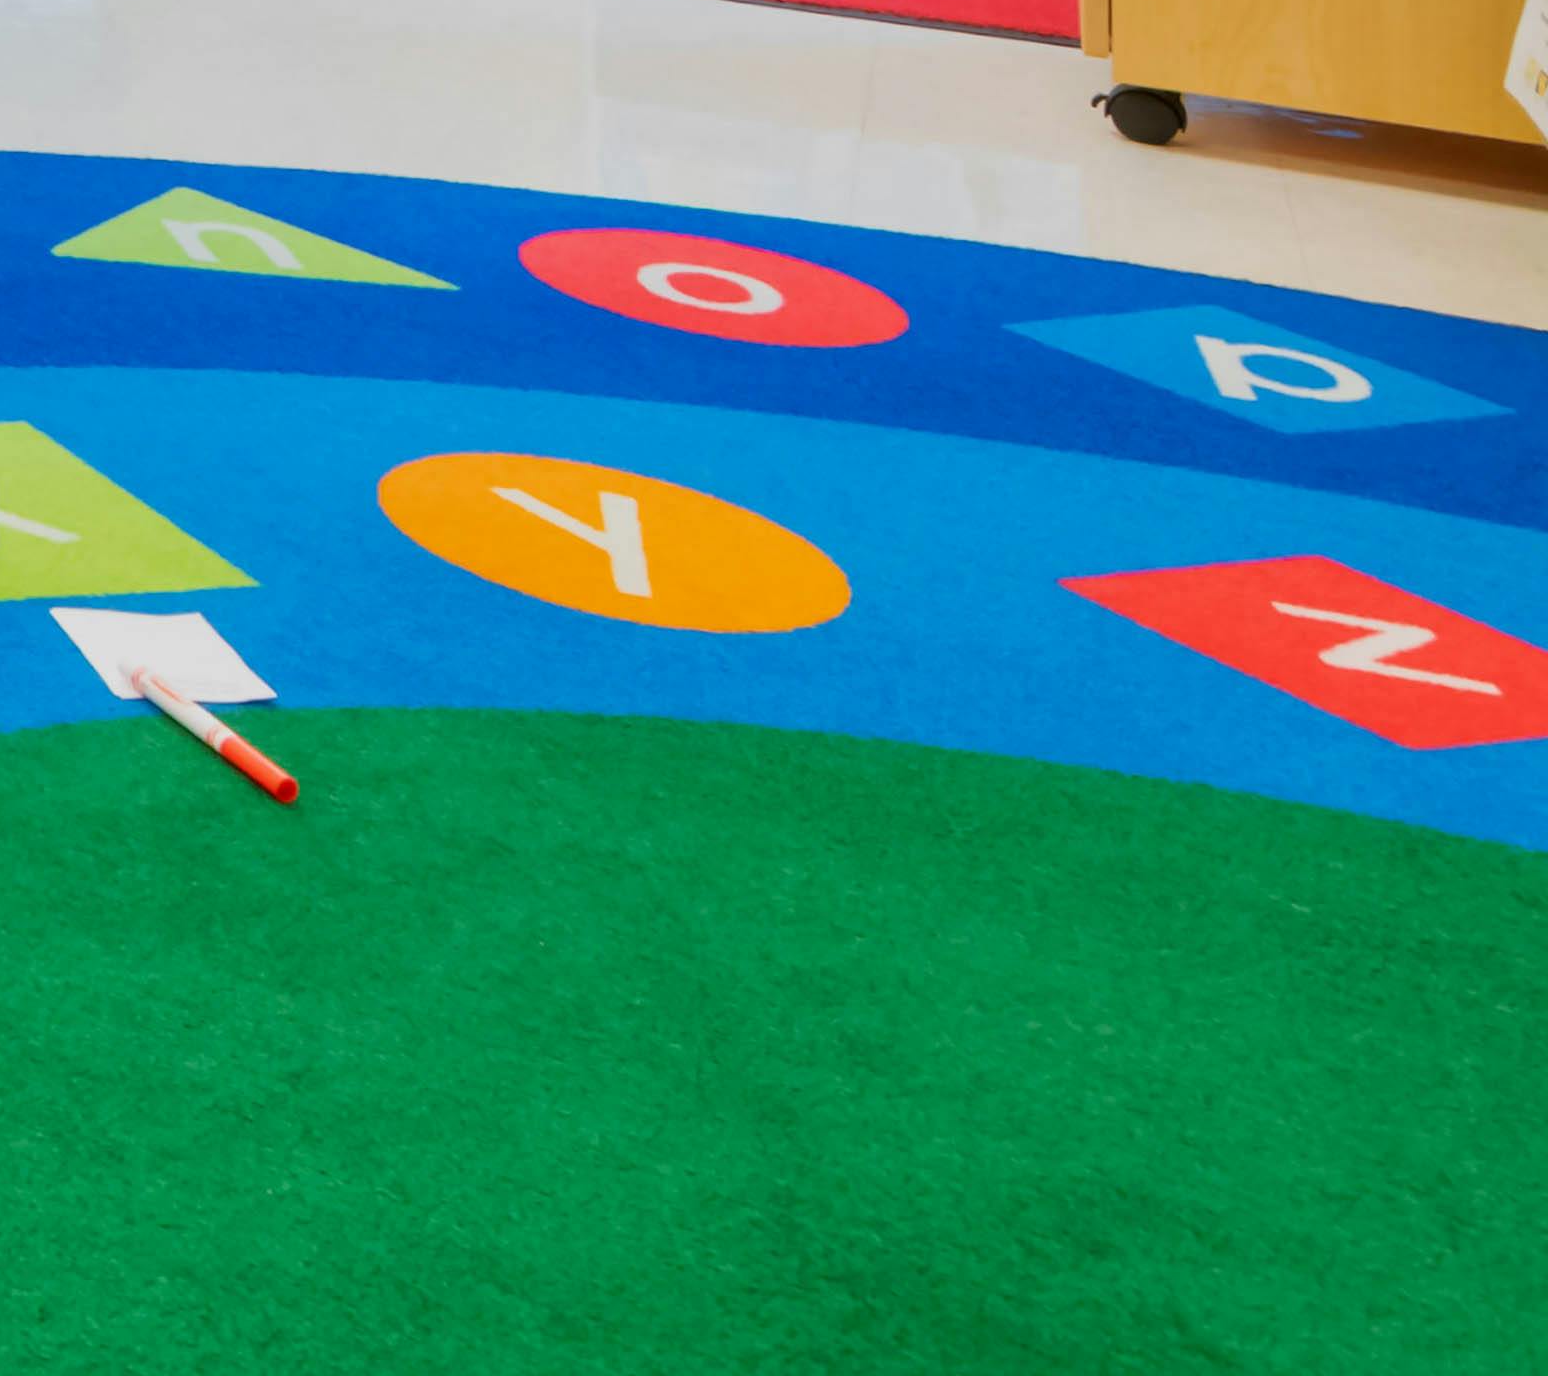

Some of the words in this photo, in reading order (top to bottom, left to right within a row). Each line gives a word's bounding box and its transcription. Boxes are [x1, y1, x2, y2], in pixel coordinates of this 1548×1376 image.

[159, 215, 305, 272] n
[636, 261, 785, 315] o
[1195, 334, 1372, 403] p
[495, 487, 651, 597] y
[1274, 603, 1499, 695] z
